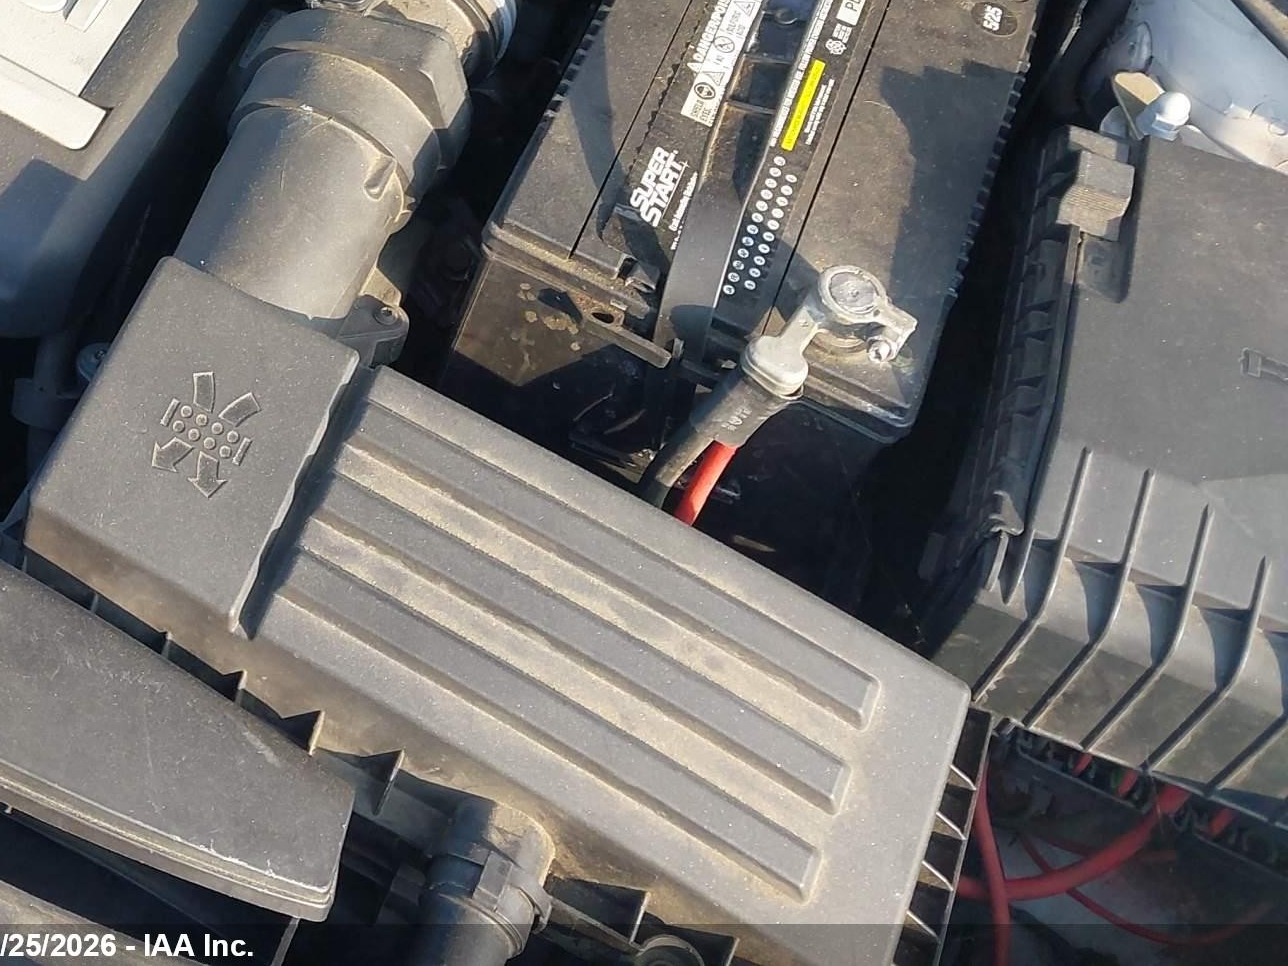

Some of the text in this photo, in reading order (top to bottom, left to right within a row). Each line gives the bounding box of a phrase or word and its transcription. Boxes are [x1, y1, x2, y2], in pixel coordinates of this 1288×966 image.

[982, 3, 1003, 31] 5/25
[627, 144, 670, 216] SUPER
[640, 151, 683, 228] START
